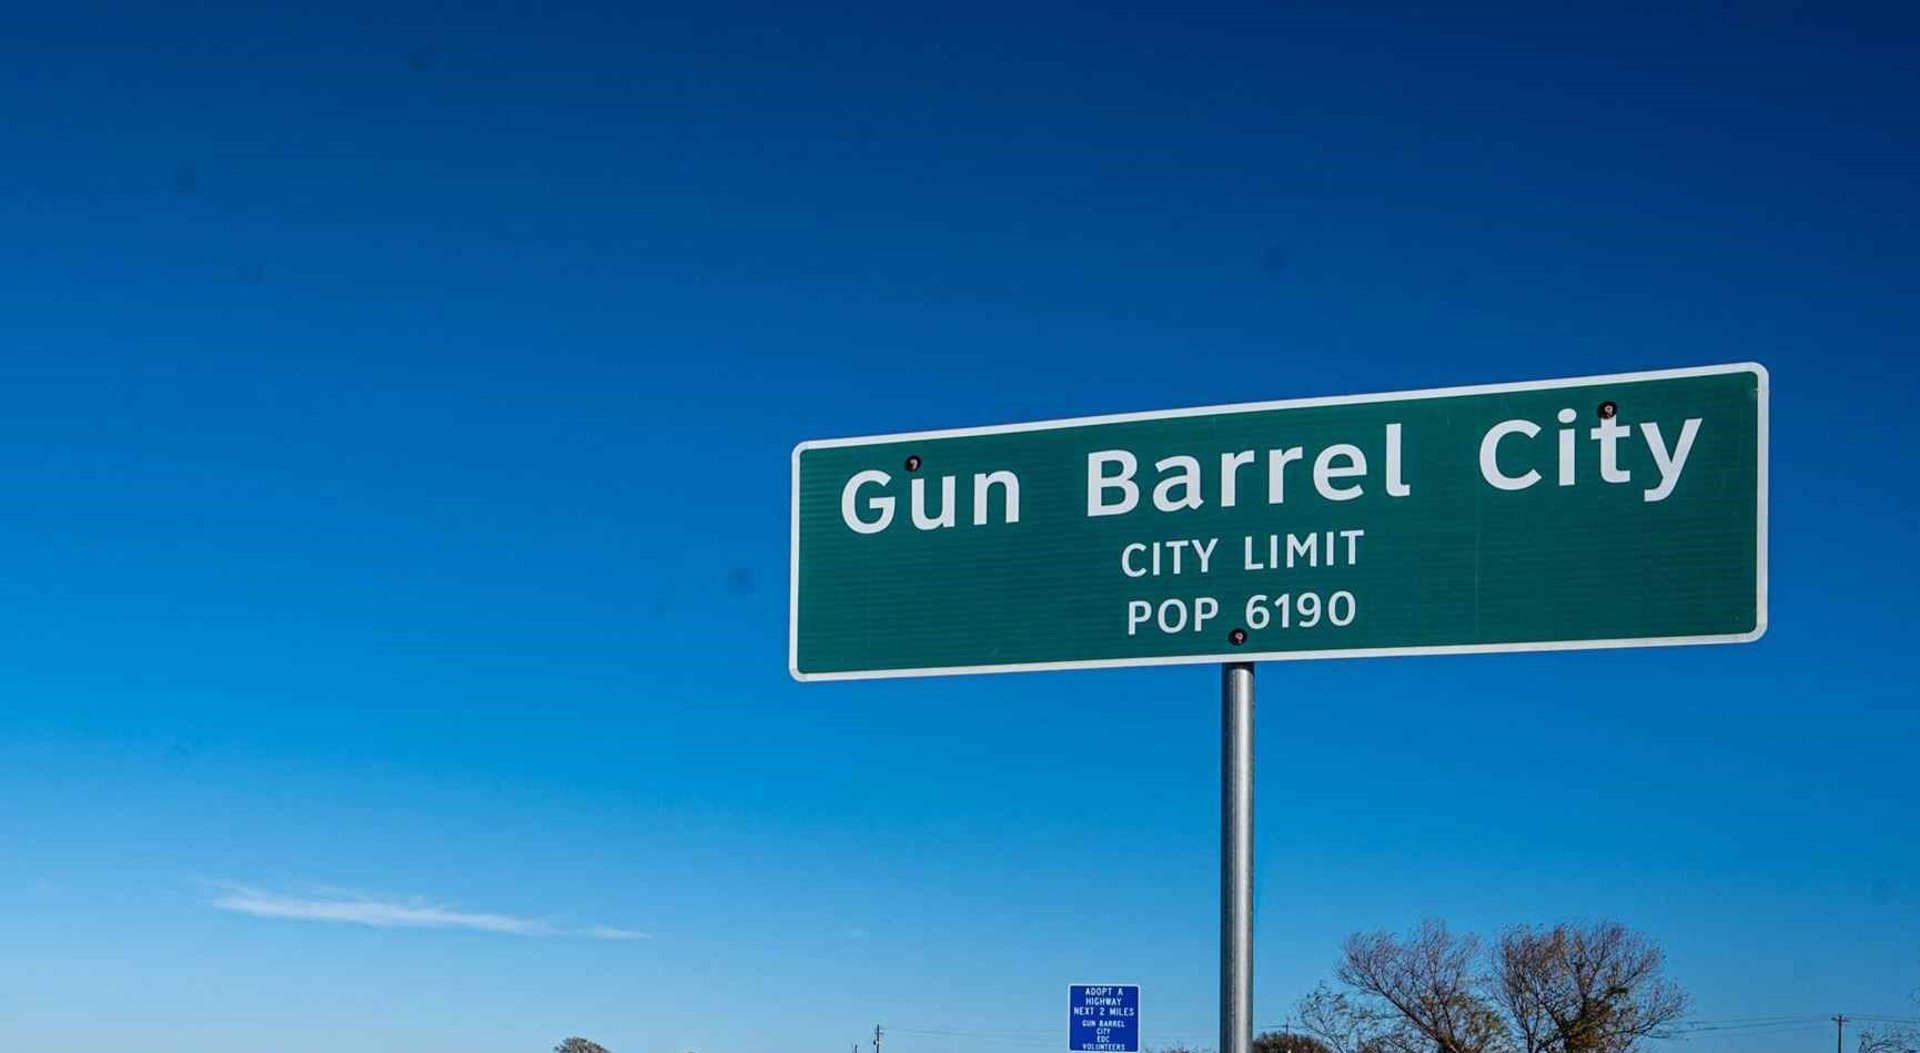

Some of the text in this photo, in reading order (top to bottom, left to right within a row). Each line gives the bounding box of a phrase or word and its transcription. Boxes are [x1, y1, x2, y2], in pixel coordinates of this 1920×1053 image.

[841, 408, 1703, 534] Gun Barrel City
[1121, 529, 1364, 578] CITY LIMIT
[1127, 590, 1357, 636] POP 6190
[1085, 987, 1123, 996] ADOPT A
[1085, 997, 1122, 1006] HIGHWAY
[1073, 1006, 1135, 1016] NEXT 2 MILES
[1082, 1019, 1125, 1027] GUN BARREL
[1096, 1035, 1110, 1043] EDC
[1082, 1043, 1126, 1051] VOLUNTEERS
